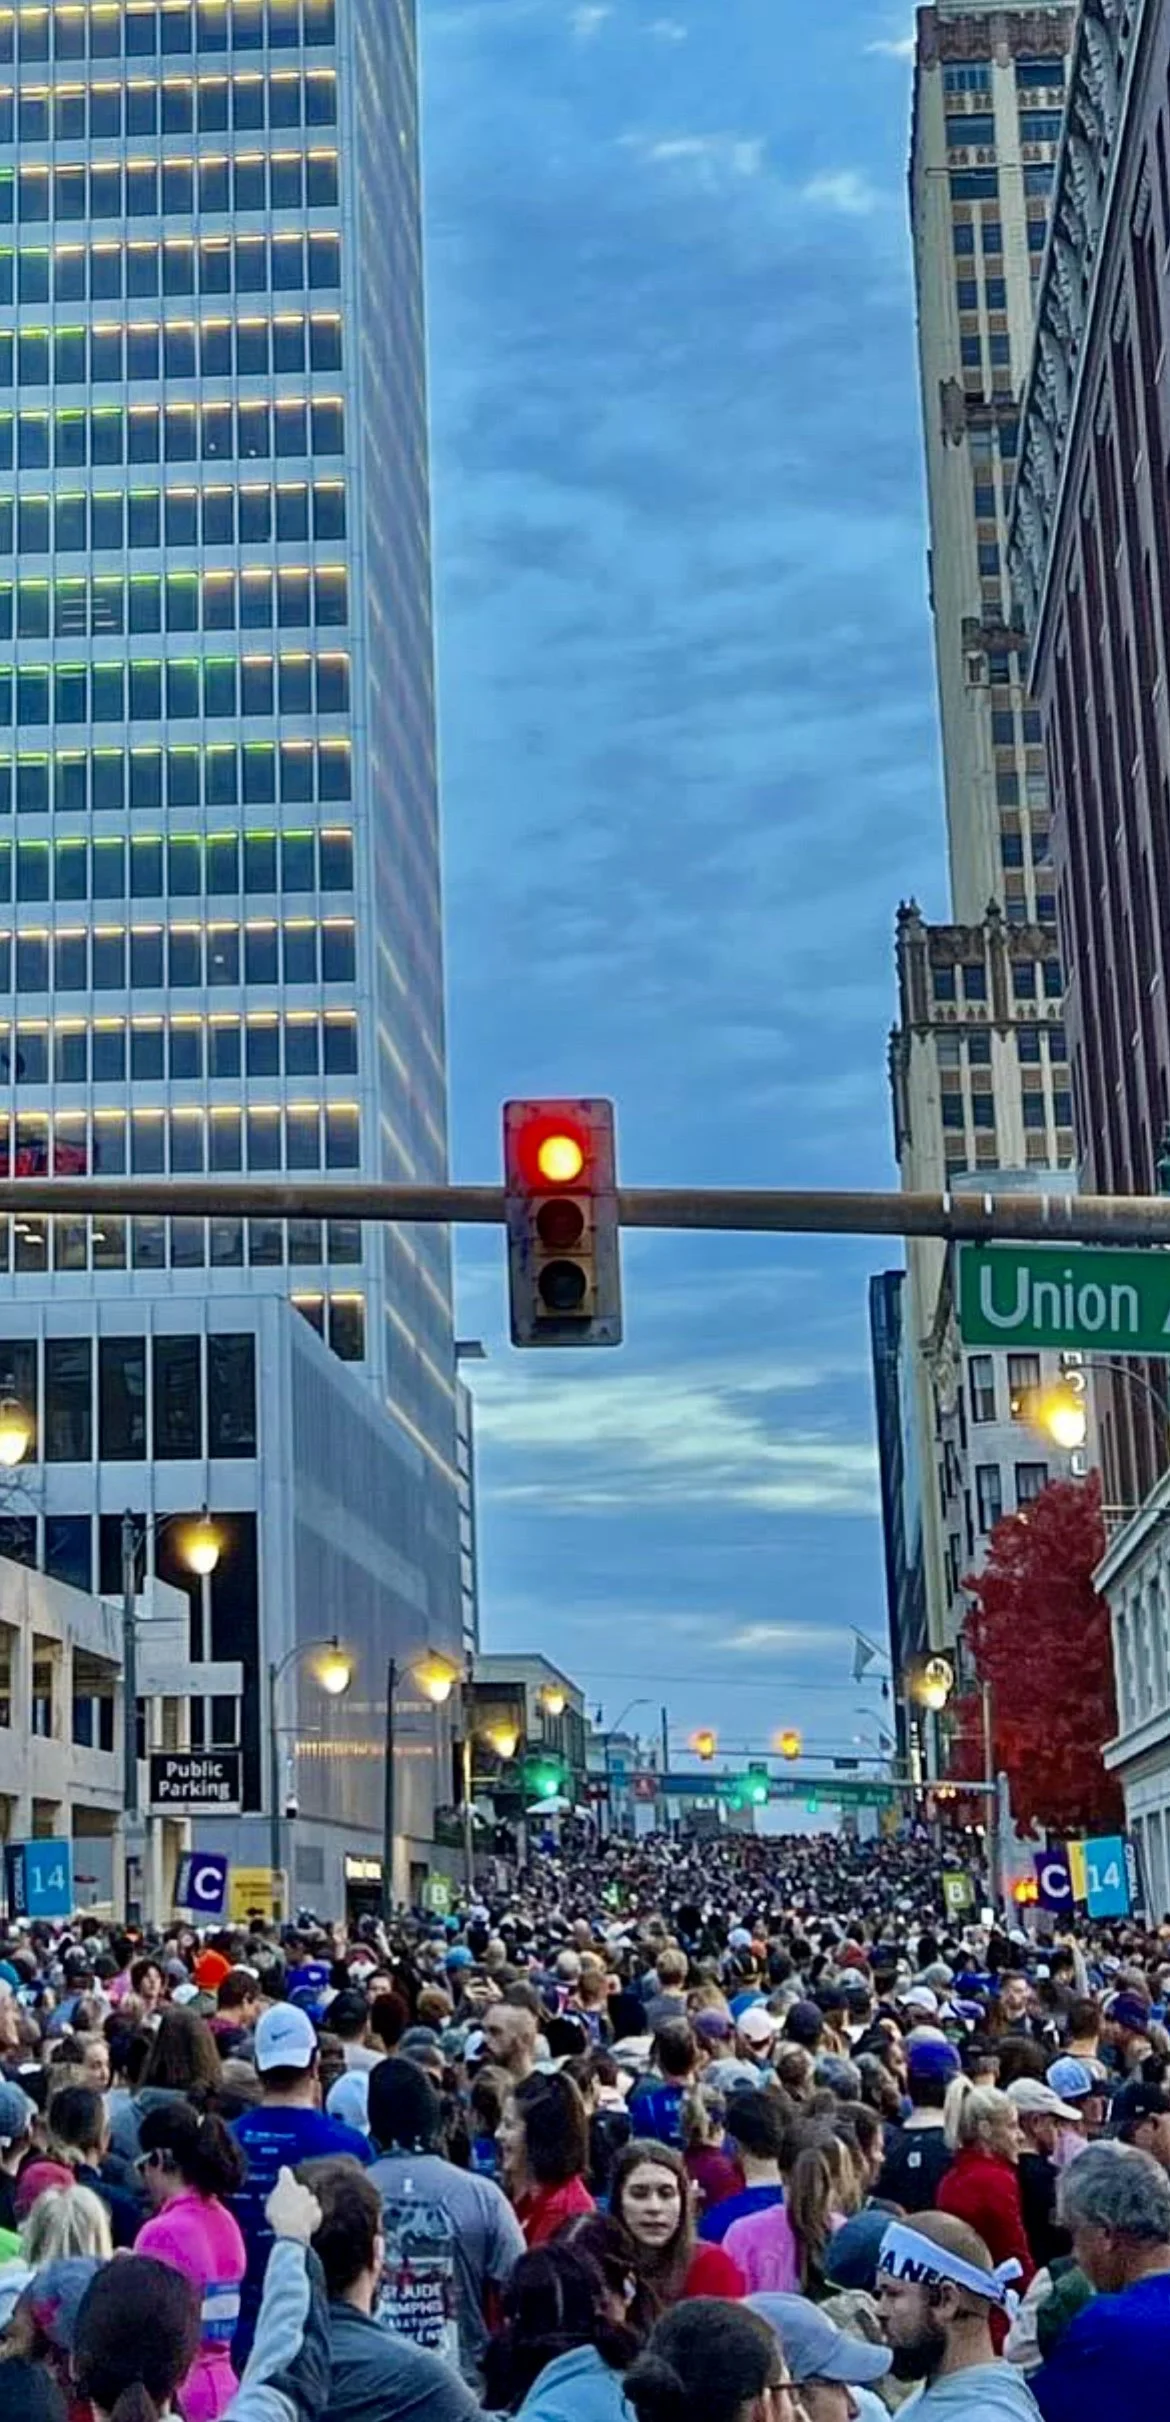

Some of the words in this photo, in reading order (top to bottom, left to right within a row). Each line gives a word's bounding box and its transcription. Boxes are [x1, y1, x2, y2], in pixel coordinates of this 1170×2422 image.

[980, 1264, 1139, 1333] Union
[166, 1760, 223, 1778] Public
[159, 1778, 230, 1800] Parking
[30, 1864, 66, 1893] 14
[194, 1866, 223, 1900] C
[1041, 1863, 1071, 1899] C
[1087, 1860, 1120, 1894] 14
[430, 1884, 448, 1905] B
[949, 1881, 966, 1903] B
